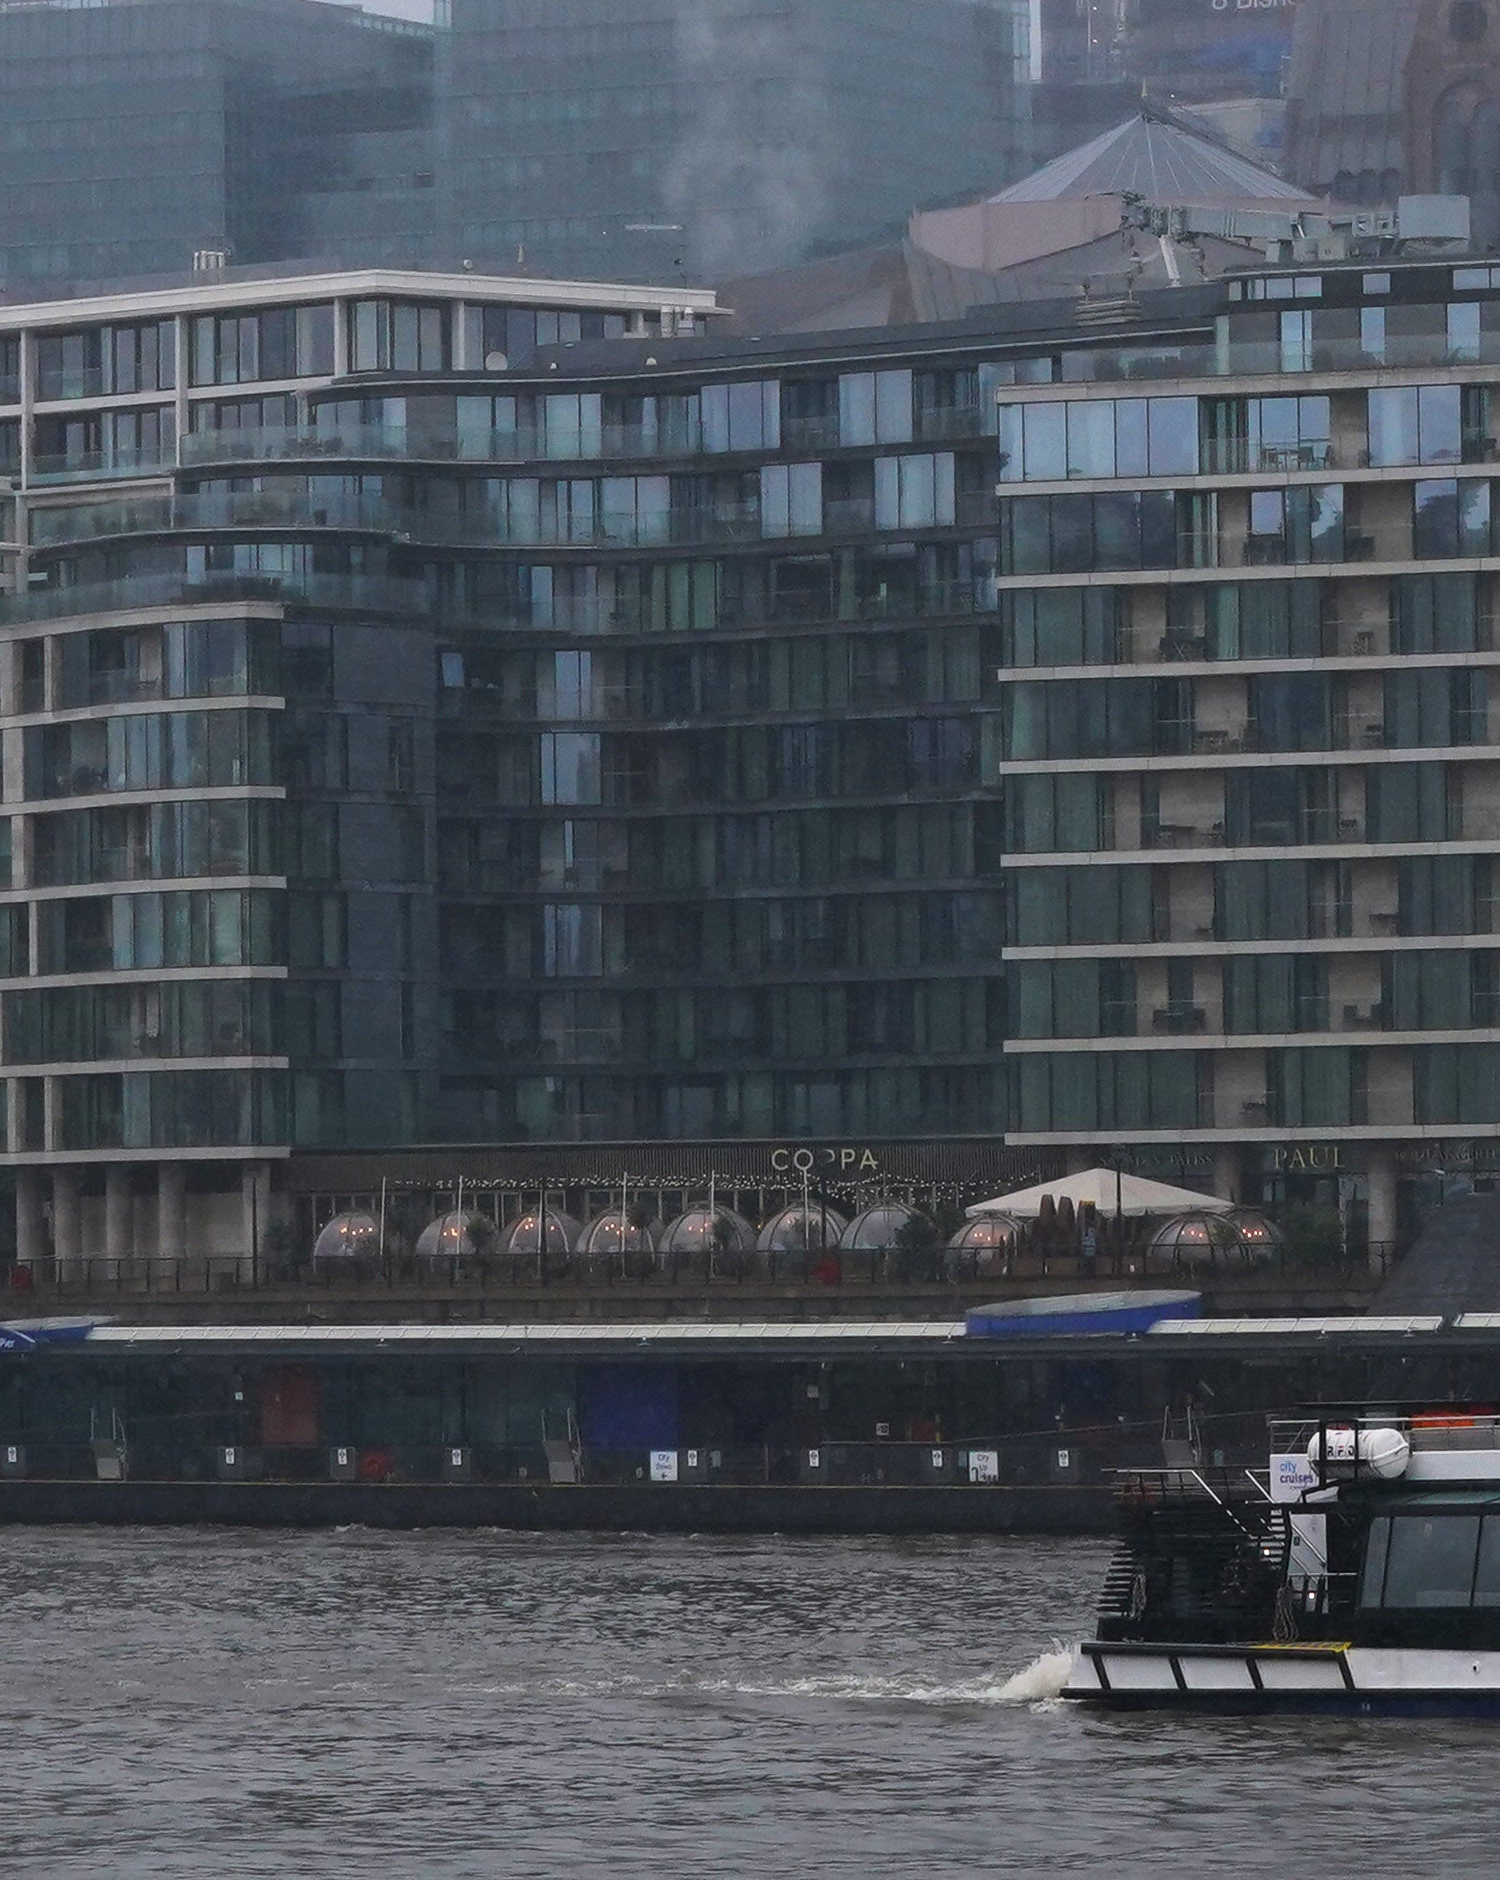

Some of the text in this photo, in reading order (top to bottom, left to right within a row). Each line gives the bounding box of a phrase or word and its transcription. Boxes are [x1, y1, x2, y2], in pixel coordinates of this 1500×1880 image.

[1273, 1147, 1348, 1169] PAUL
[0, 1337, 15, 1348] Pier
[1279, 1461, 1298, 1473] city
[1279, 1472, 1314, 1484] cruises
